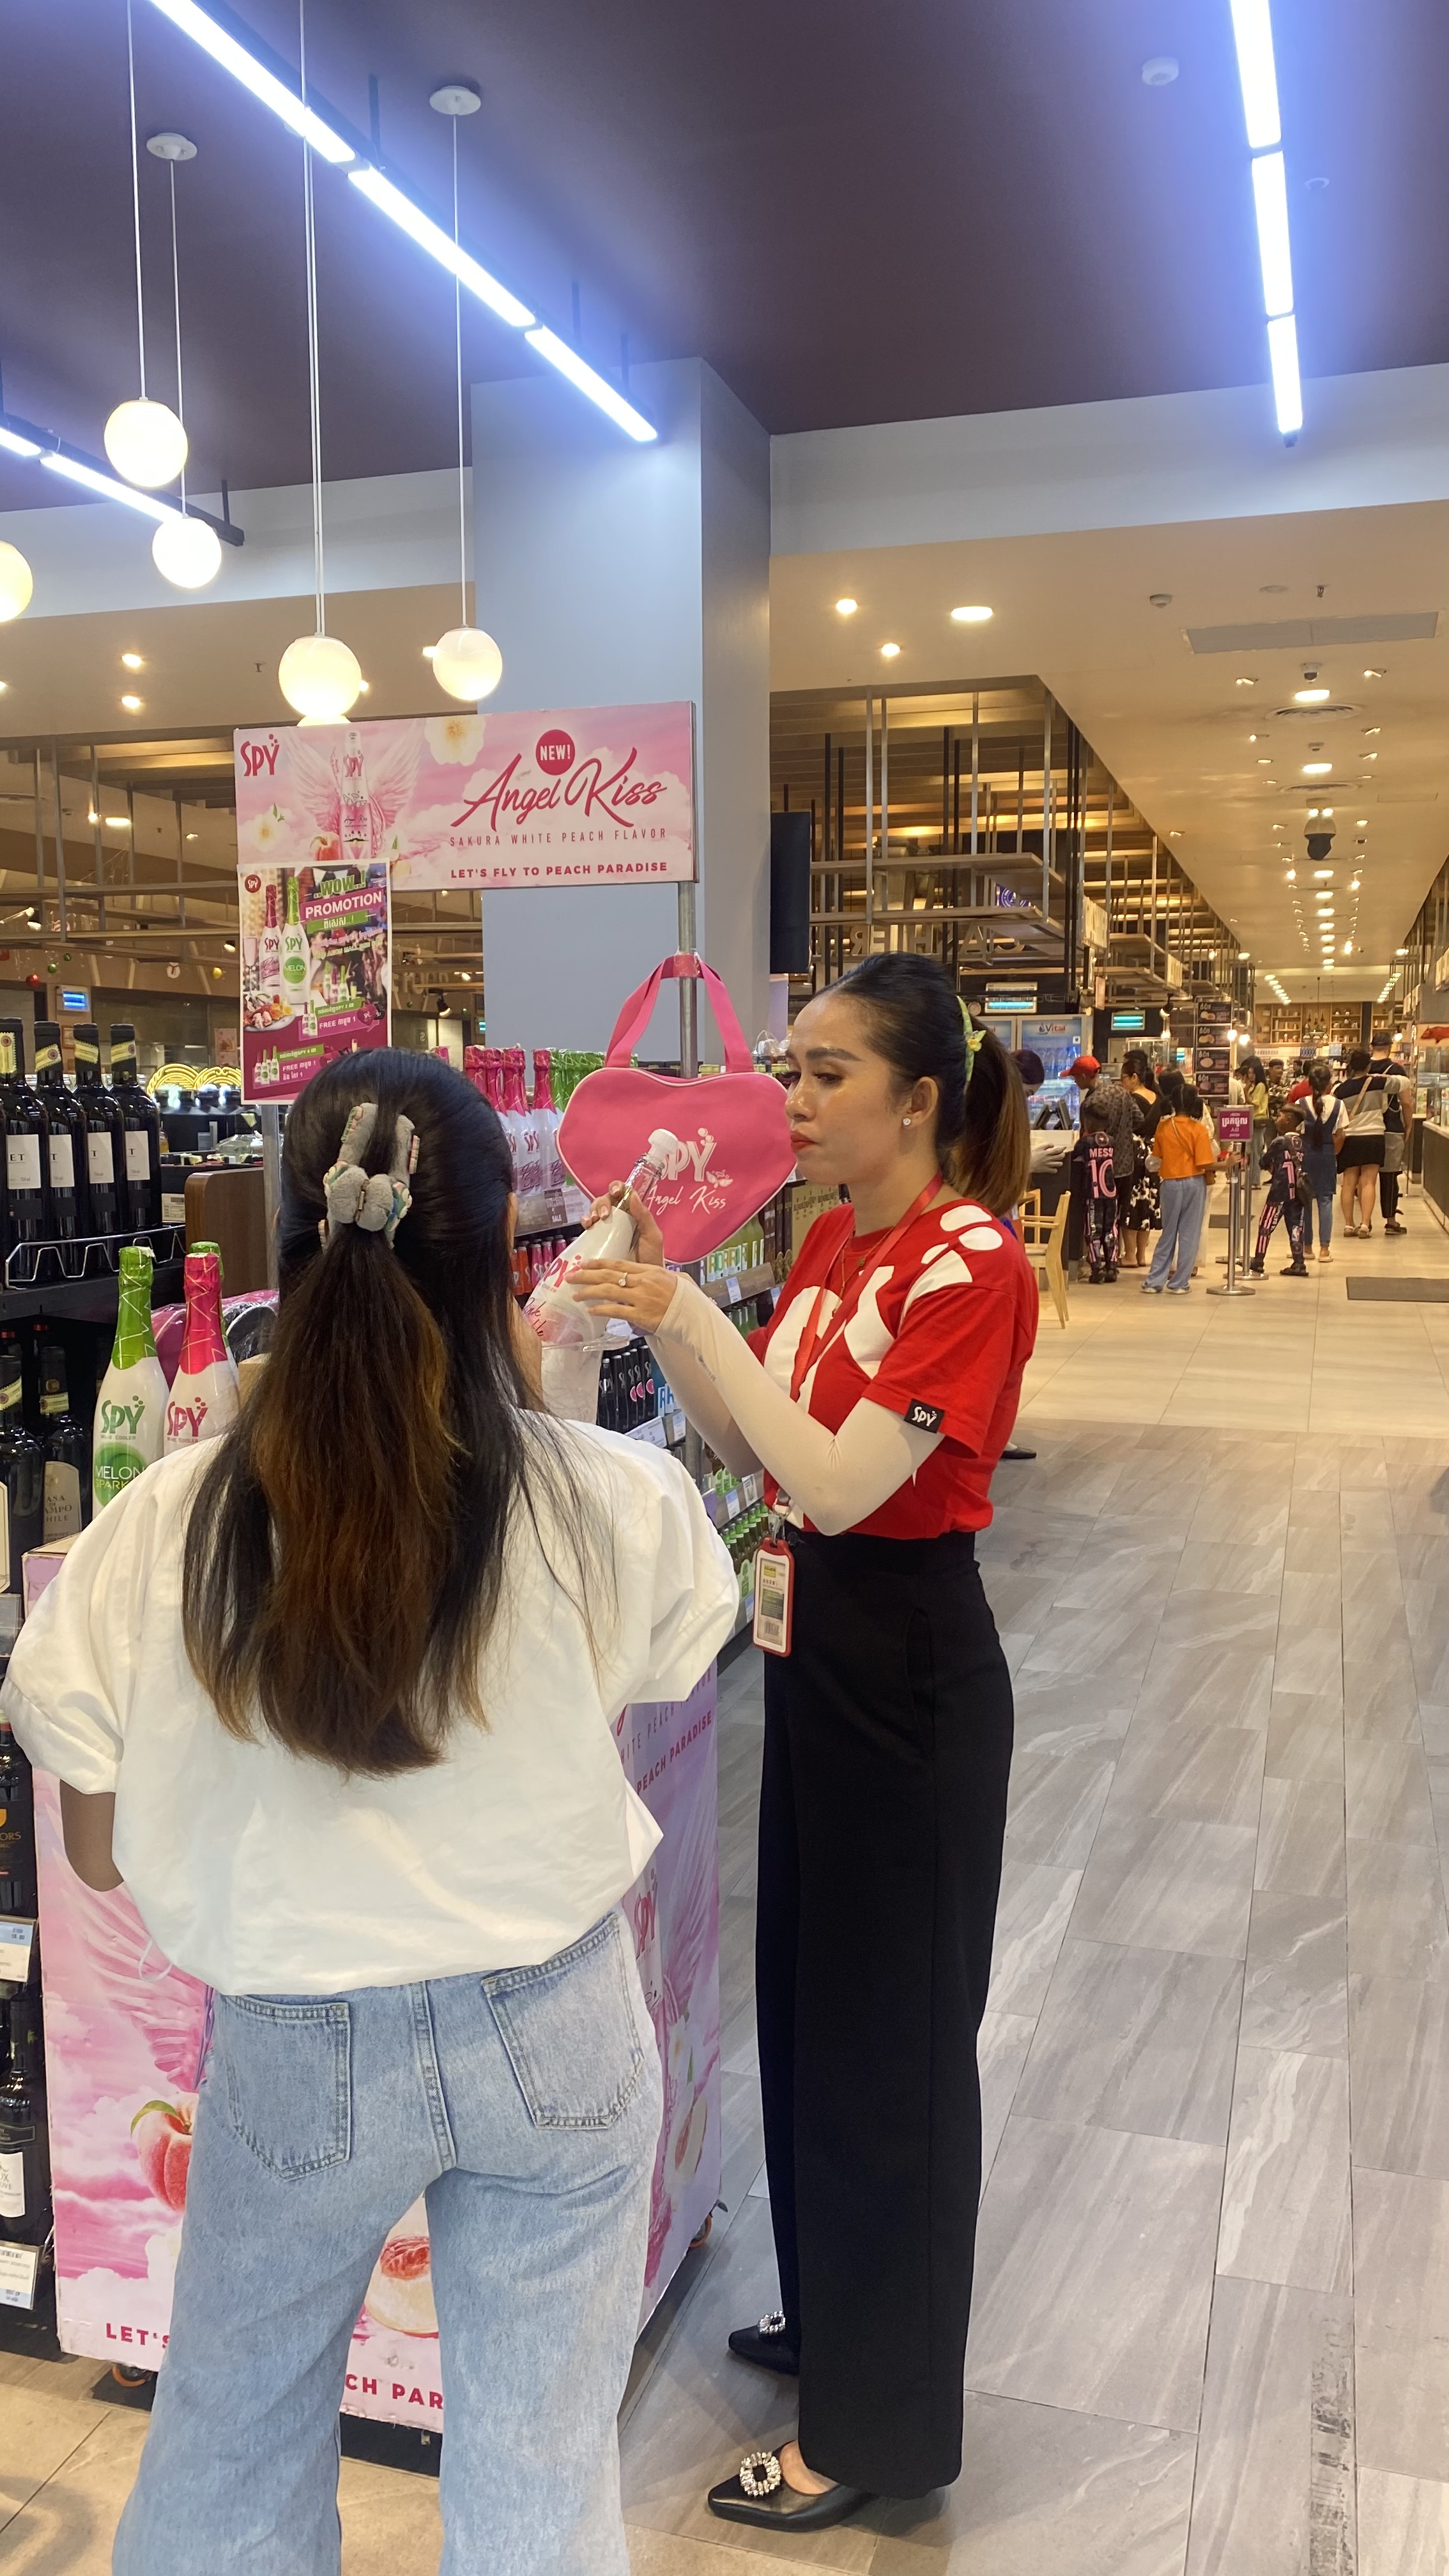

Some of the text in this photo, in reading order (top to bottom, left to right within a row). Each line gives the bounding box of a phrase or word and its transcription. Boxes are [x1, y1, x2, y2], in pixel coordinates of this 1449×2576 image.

[240, 739, 280, 777] SPY
[540, 744, 571, 761] NEW!
[450, 746, 668, 832] Angel Kiss
[450, 828, 666, 847] SAKURA WHITE PEACH FLAVOR
[450, 862, 668, 878] LET'S FLY TO PEACH PARADISE
[247, 878, 258, 889] SPY
[305, 891, 382, 919] PROMOTION
[264, 936, 280, 950] SPY
[285, 936, 303, 951] SPY
[284, 963, 307, 972] MELON
[319, 1020, 337, 1029] FREE
[1046, 1023, 1066, 1032] Vital
[661, 1140, 717, 1182] PY
[1088, 1159, 1117, 1199] 10
[689, 1185, 726, 1215] Kiss
[101, 1399, 146, 1434] SPY
[167, 1400, 208, 1437] SPY
[911, 1406, 937, 1427] SPY
[95, 1465, 145, 1480] MELON
[95, 1479, 129, 1490] SPARK
[44, 1504, 72, 1514] AMPO
[45, 1514, 69, 1522] HILE
[620, 1733, 641, 1765] HITE
[636, 1754, 666, 1796] PEACH
[670, 1710, 712, 1763] PARADISE
